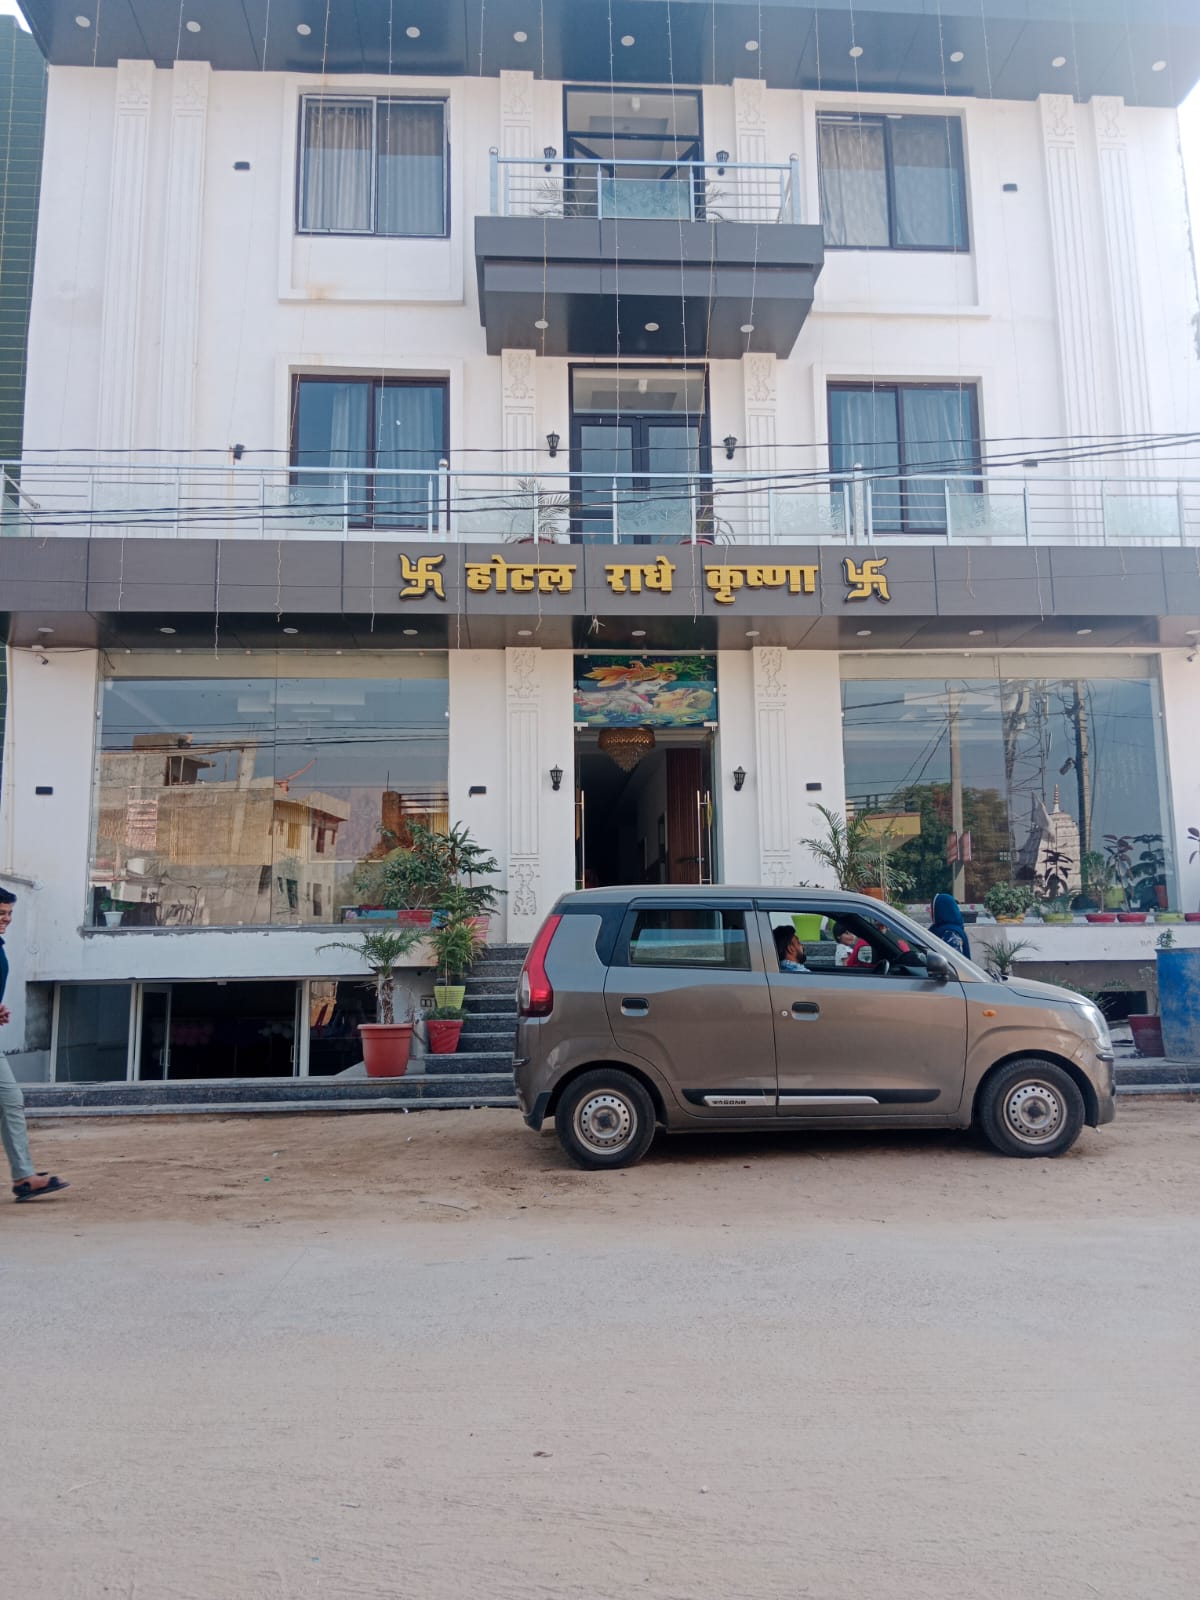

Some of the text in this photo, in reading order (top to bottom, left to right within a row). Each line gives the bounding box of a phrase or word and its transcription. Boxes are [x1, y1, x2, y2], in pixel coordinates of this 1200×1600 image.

[465, 555, 819, 604] होटल राधे कृष्णा
